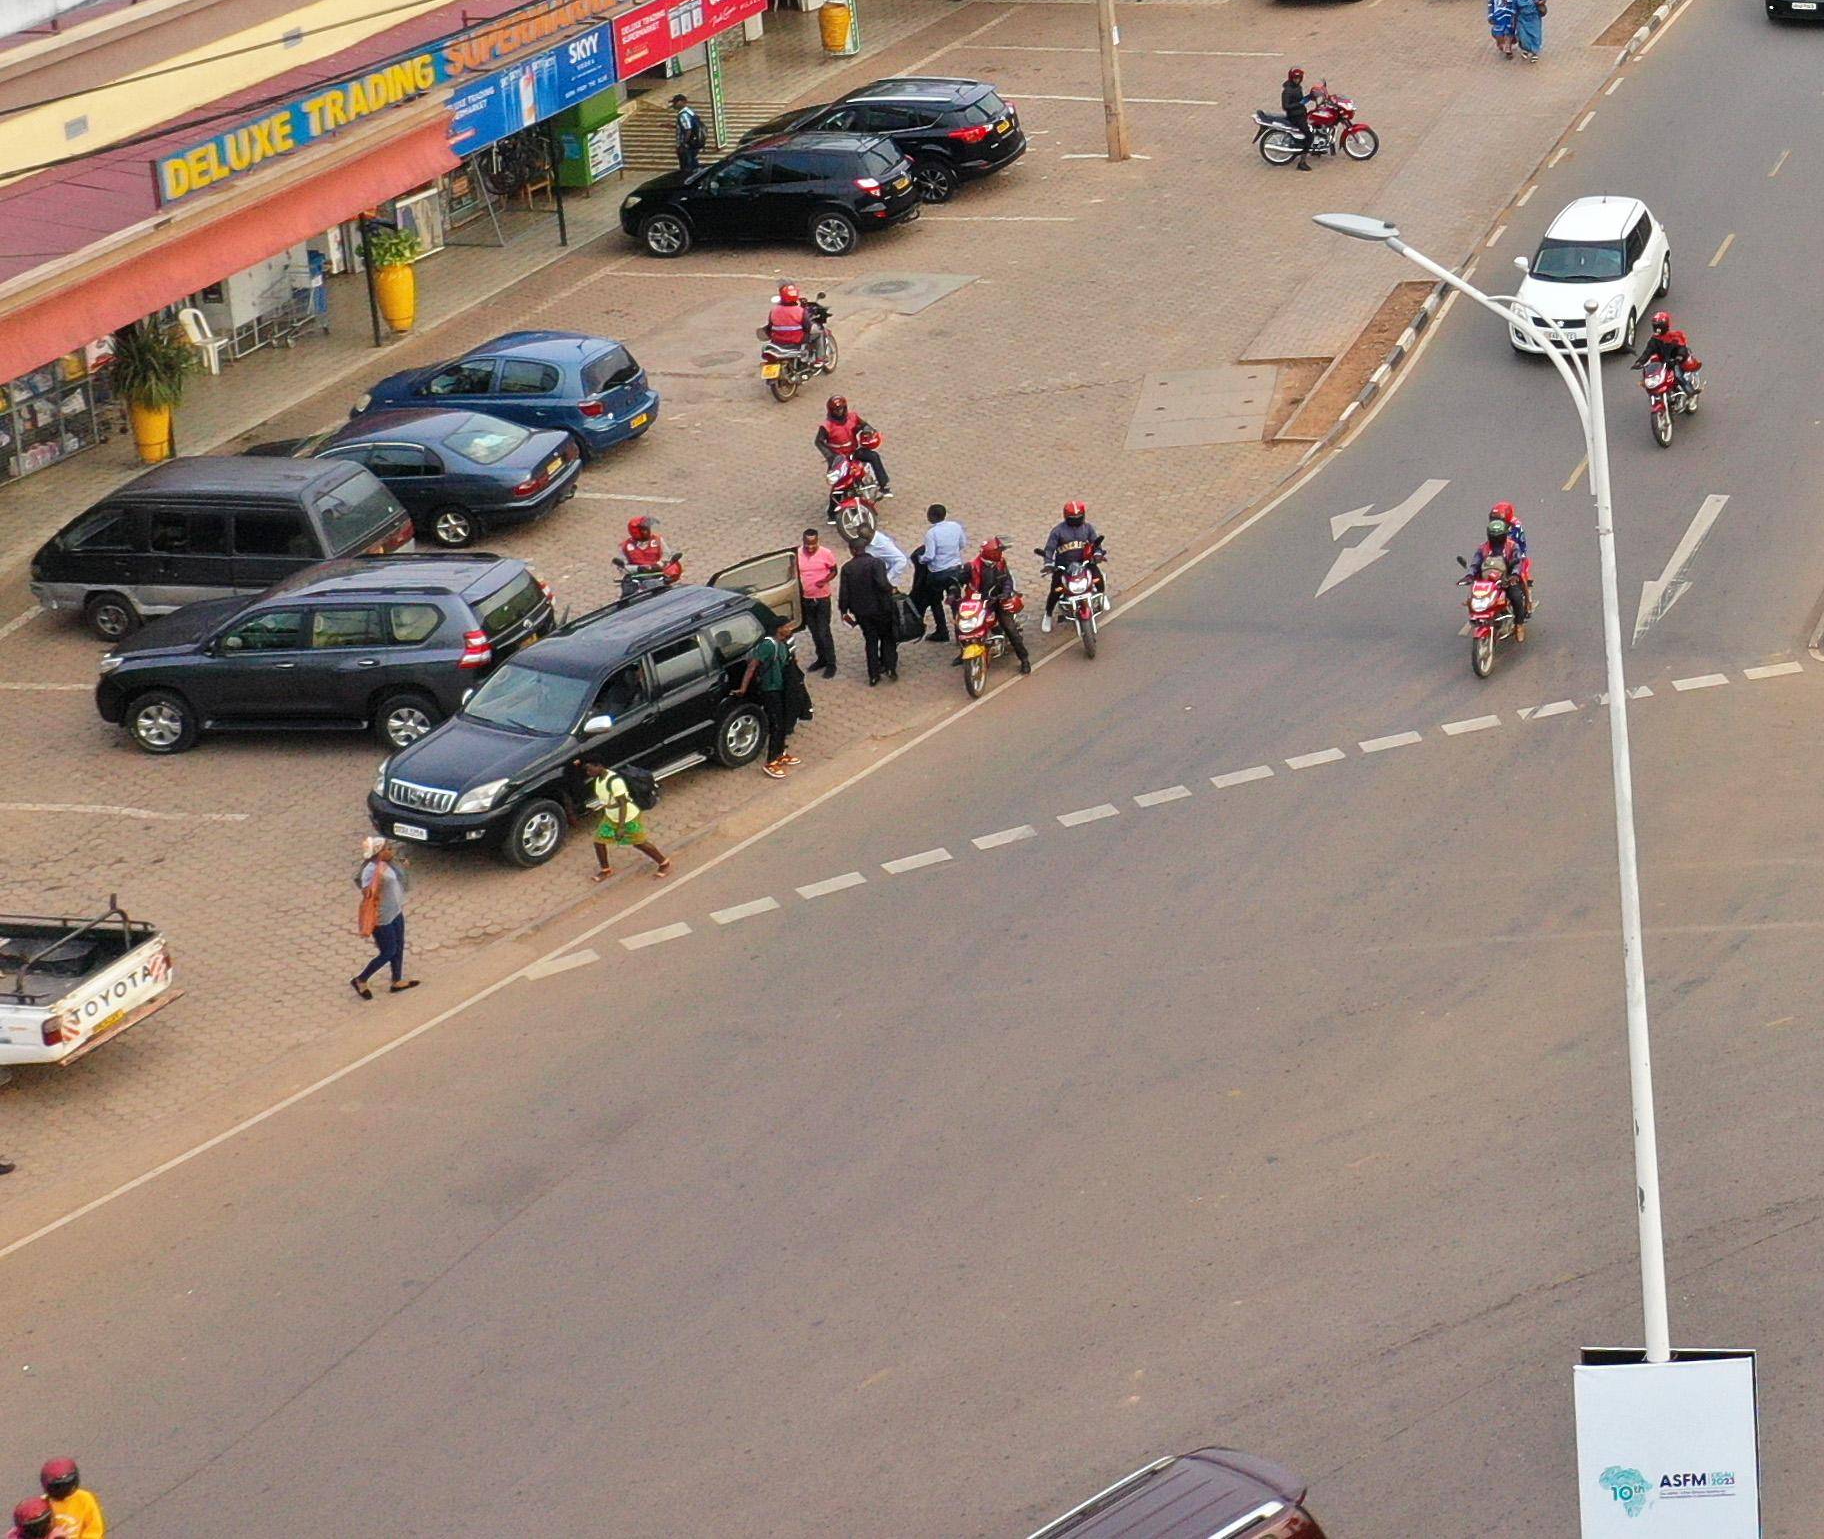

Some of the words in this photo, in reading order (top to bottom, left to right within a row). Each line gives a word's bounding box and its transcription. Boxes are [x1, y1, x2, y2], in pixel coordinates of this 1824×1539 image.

[568, 32, 599, 65] SKYY
[165, 110, 295, 201] DELUXE
[303, 53, 436, 137] TRADING
[70, 965, 152, 1024] TOYOTA
[1659, 1472, 1707, 1488] ASFM
[1711, 1477, 1735, 1486] 2023
